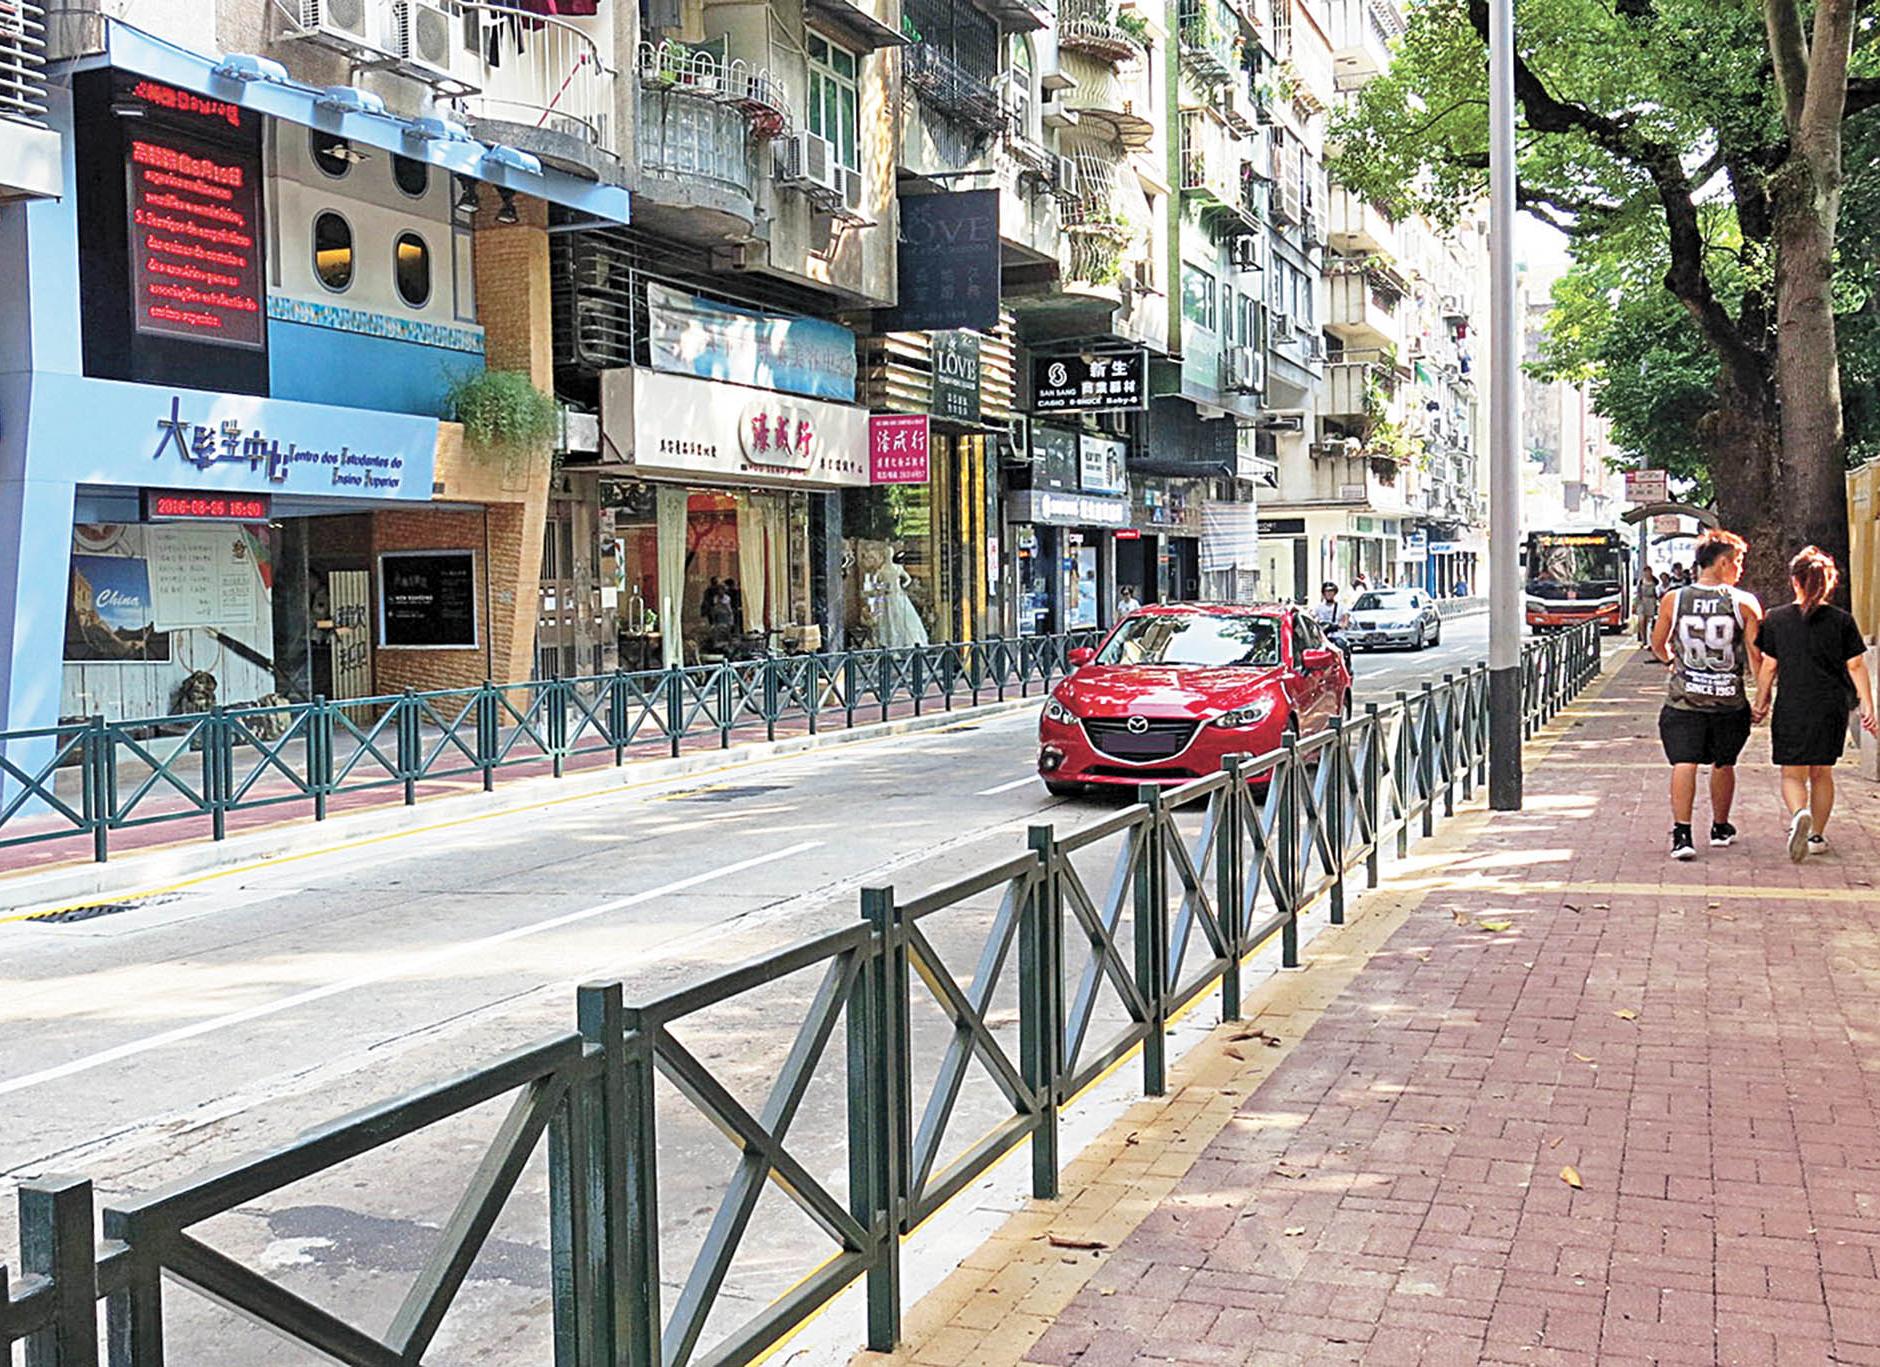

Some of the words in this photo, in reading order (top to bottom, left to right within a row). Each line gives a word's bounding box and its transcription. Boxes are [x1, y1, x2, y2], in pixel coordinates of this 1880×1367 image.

[938, 351, 977, 381] LOVE
[1089, 361, 1128, 377] 新生
[1038, 399, 1065, 407] CASIO
[321, 451, 338, 464] dos
[96, 588, 139, 607] China
[1692, 599, 1719, 614] FNT
[1679, 614, 1735, 671] 69
[1685, 682, 1713, 696] SINCE
